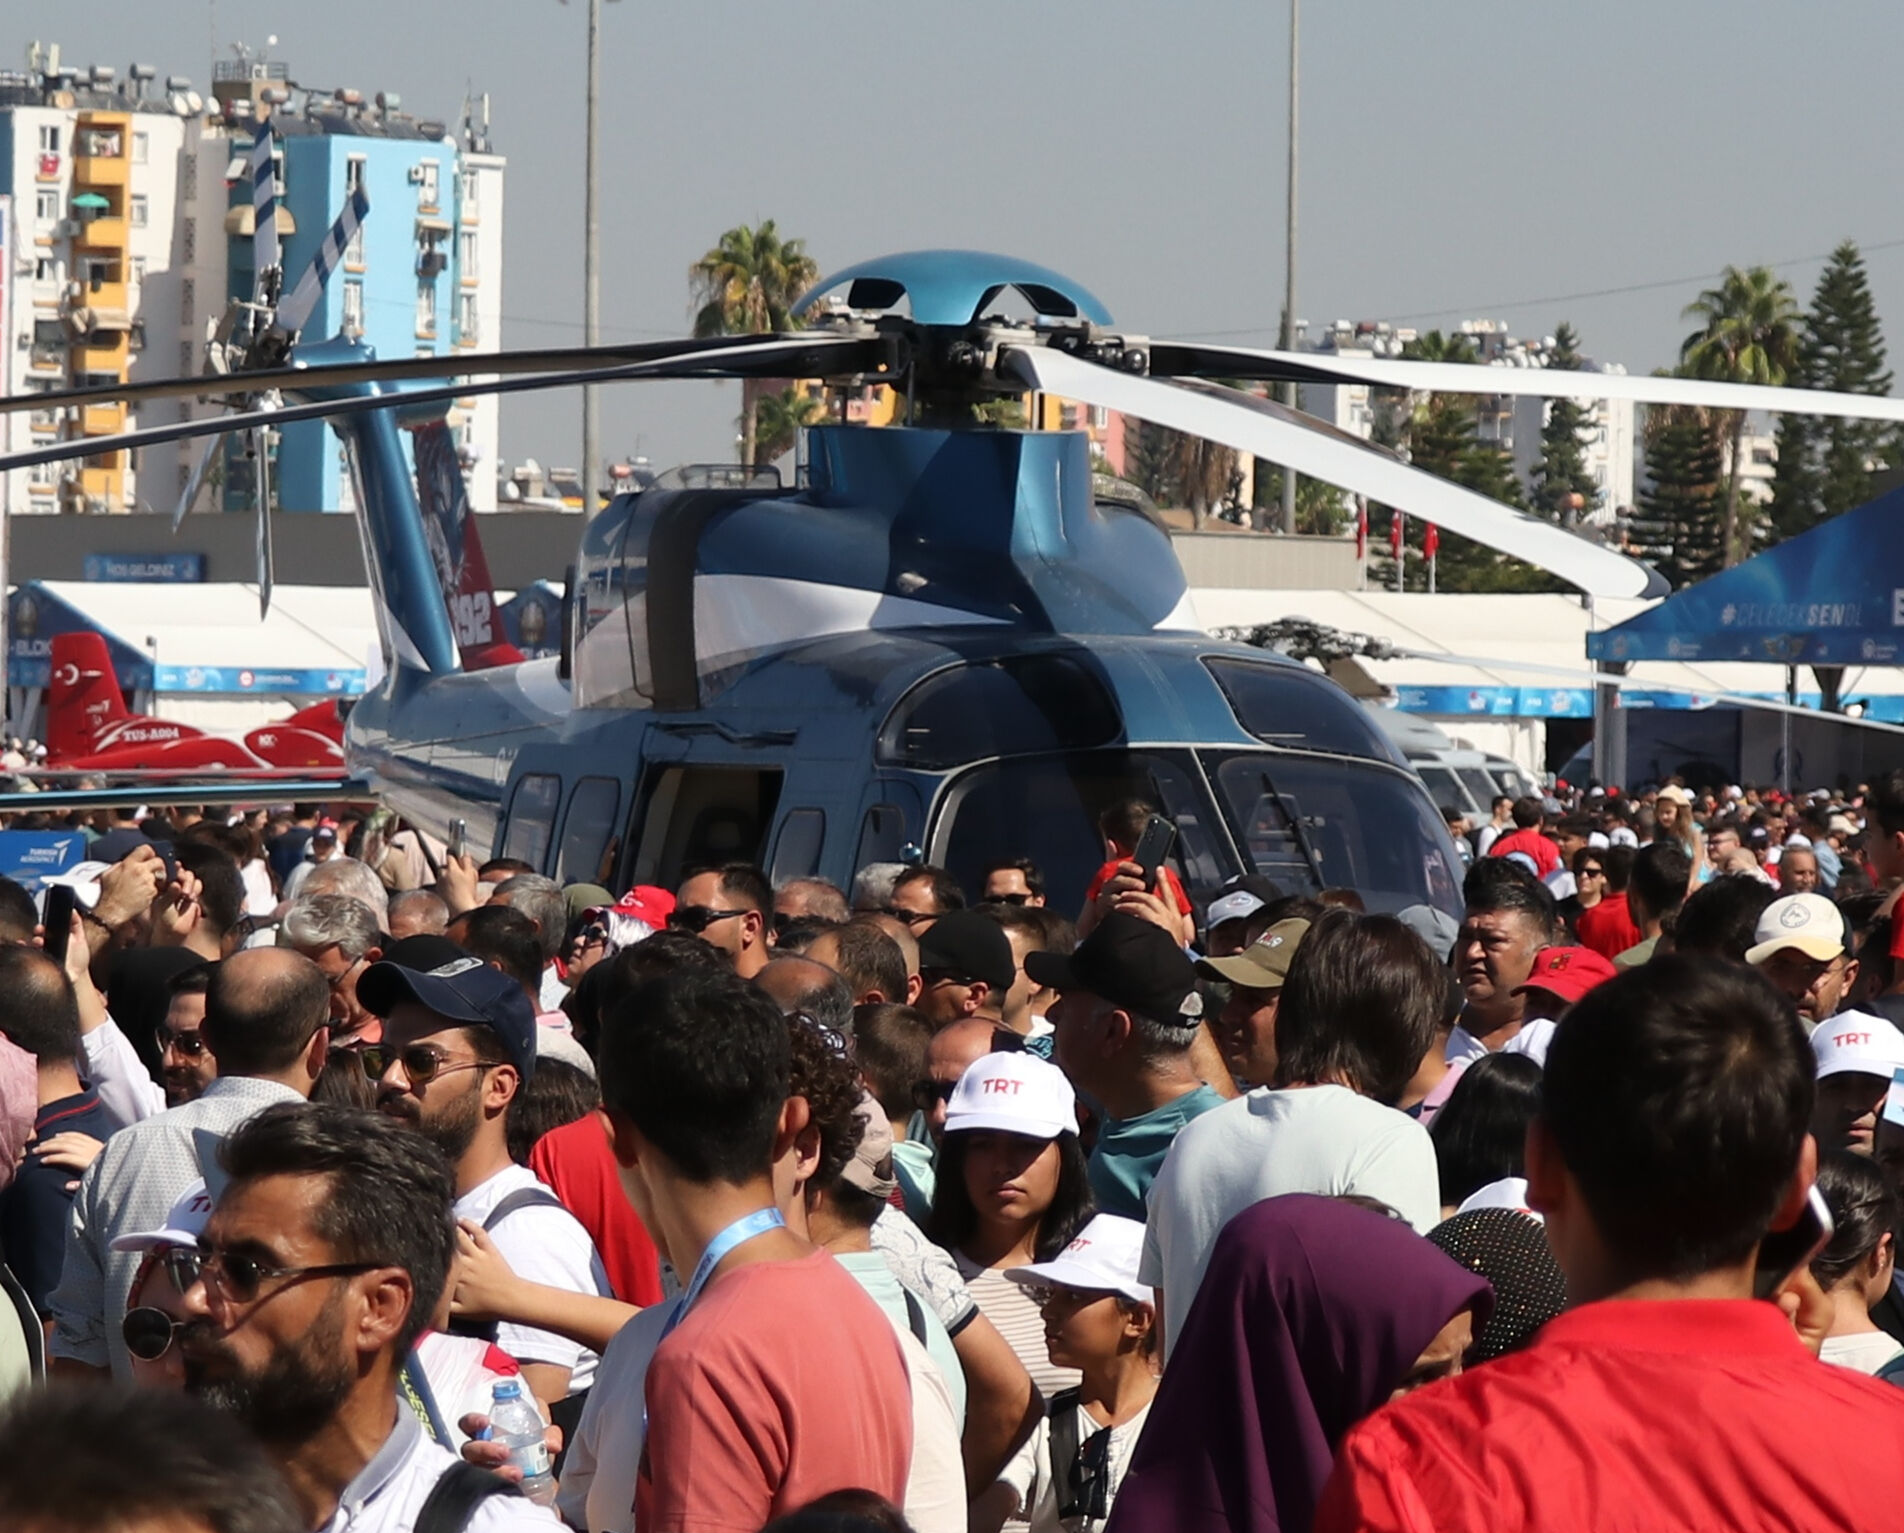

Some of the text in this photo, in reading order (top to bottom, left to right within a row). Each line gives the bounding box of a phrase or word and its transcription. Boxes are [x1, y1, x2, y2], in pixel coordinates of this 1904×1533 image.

[1833, 1032, 1872, 1048] TRT
[982, 1078, 1025, 1095] TRT
[1066, 1238, 1092, 1252] RT
